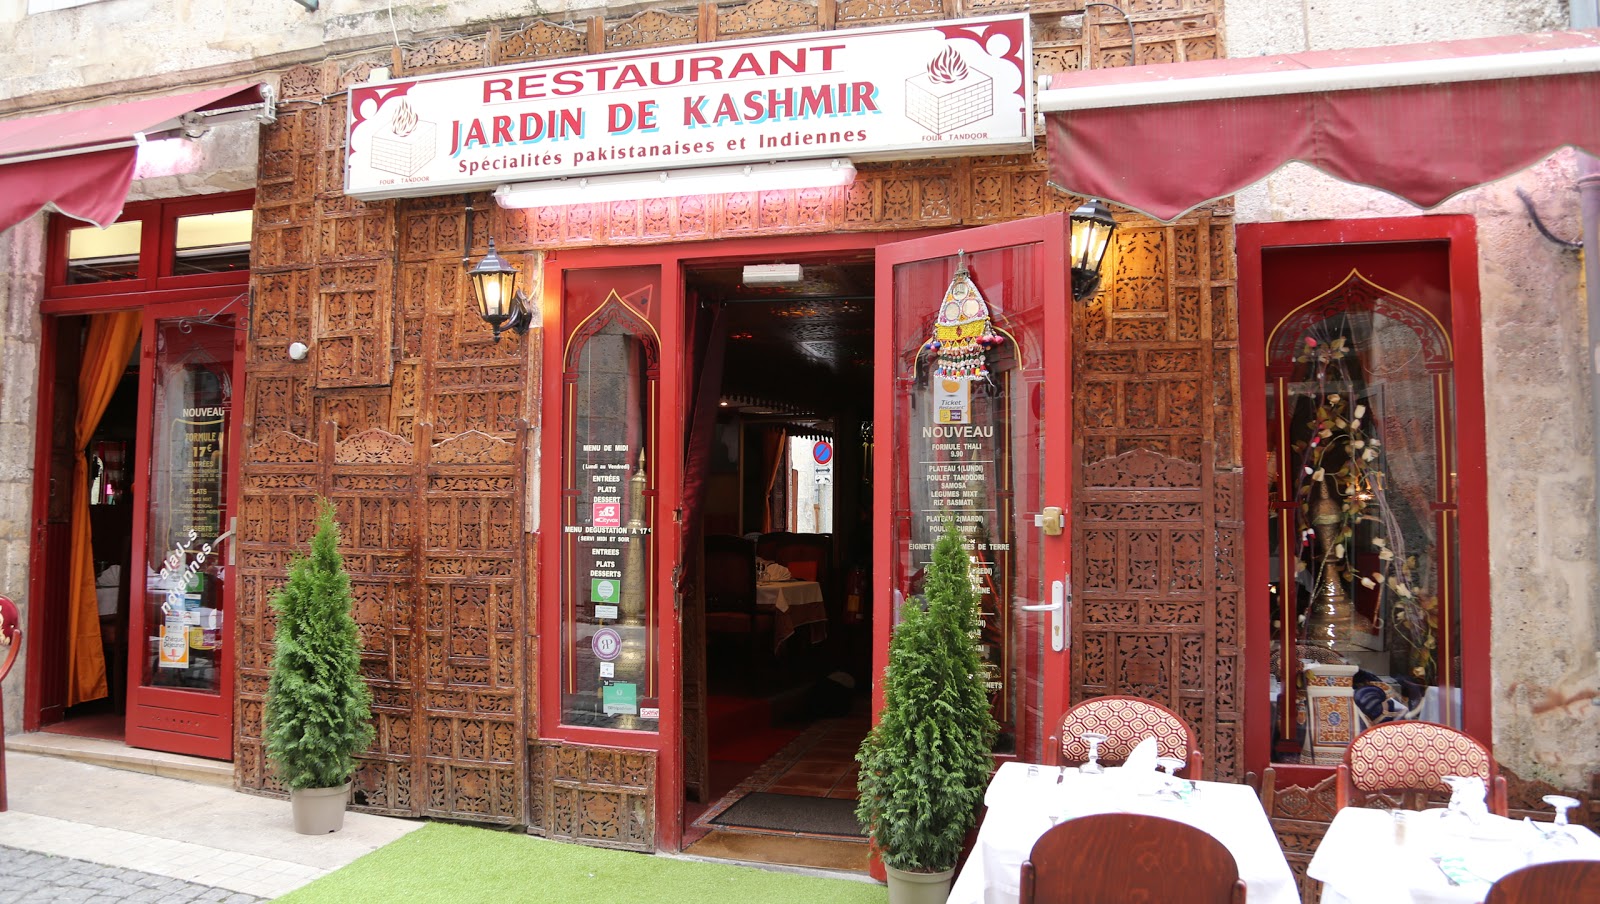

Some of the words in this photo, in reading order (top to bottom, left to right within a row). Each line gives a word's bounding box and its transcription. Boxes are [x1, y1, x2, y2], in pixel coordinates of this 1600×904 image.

[483, 45, 846, 103] RESTAURANT
[449, 107, 586, 158] JARDIN
[607, 100, 660, 136] DE
[683, 81, 883, 129] KASHMIR
[922, 134, 943, 142] FOUR
[949, 132, 989, 141] TANDOOR
[459, 150, 562, 175] Spécialités
[573, 141, 715, 166] pakistanaises
[727, 137, 746, 150] et
[760, 129, 867, 148] Indiennes
[400, 176, 430, 184] TANDOOR
[183, 407, 225, 417] NOUVEAU
[922, 425, 994, 438] NOUVEAU
[185, 432, 216, 443] FORMULE
[583, 444, 601, 452] MENU
[603, 444, 612, 452] DE
[615, 444, 629, 452] MIDI
[931, 443, 961, 451] FORMULE
[950, 450, 964, 458] 9.90
[592, 474, 620, 483] ENTRÉES
[926, 474, 950, 482] POULET
[962, 490, 978, 498] MIXT
[593, 496, 621, 504] DESSERT
[585, 526, 628, 534] DEGUSTATION
[989, 543, 1010, 551] TERRE
[591, 548, 620, 556] ENTREES
[596, 560, 616, 568] PLATS
[590, 569, 622, 578] DESSERTS
